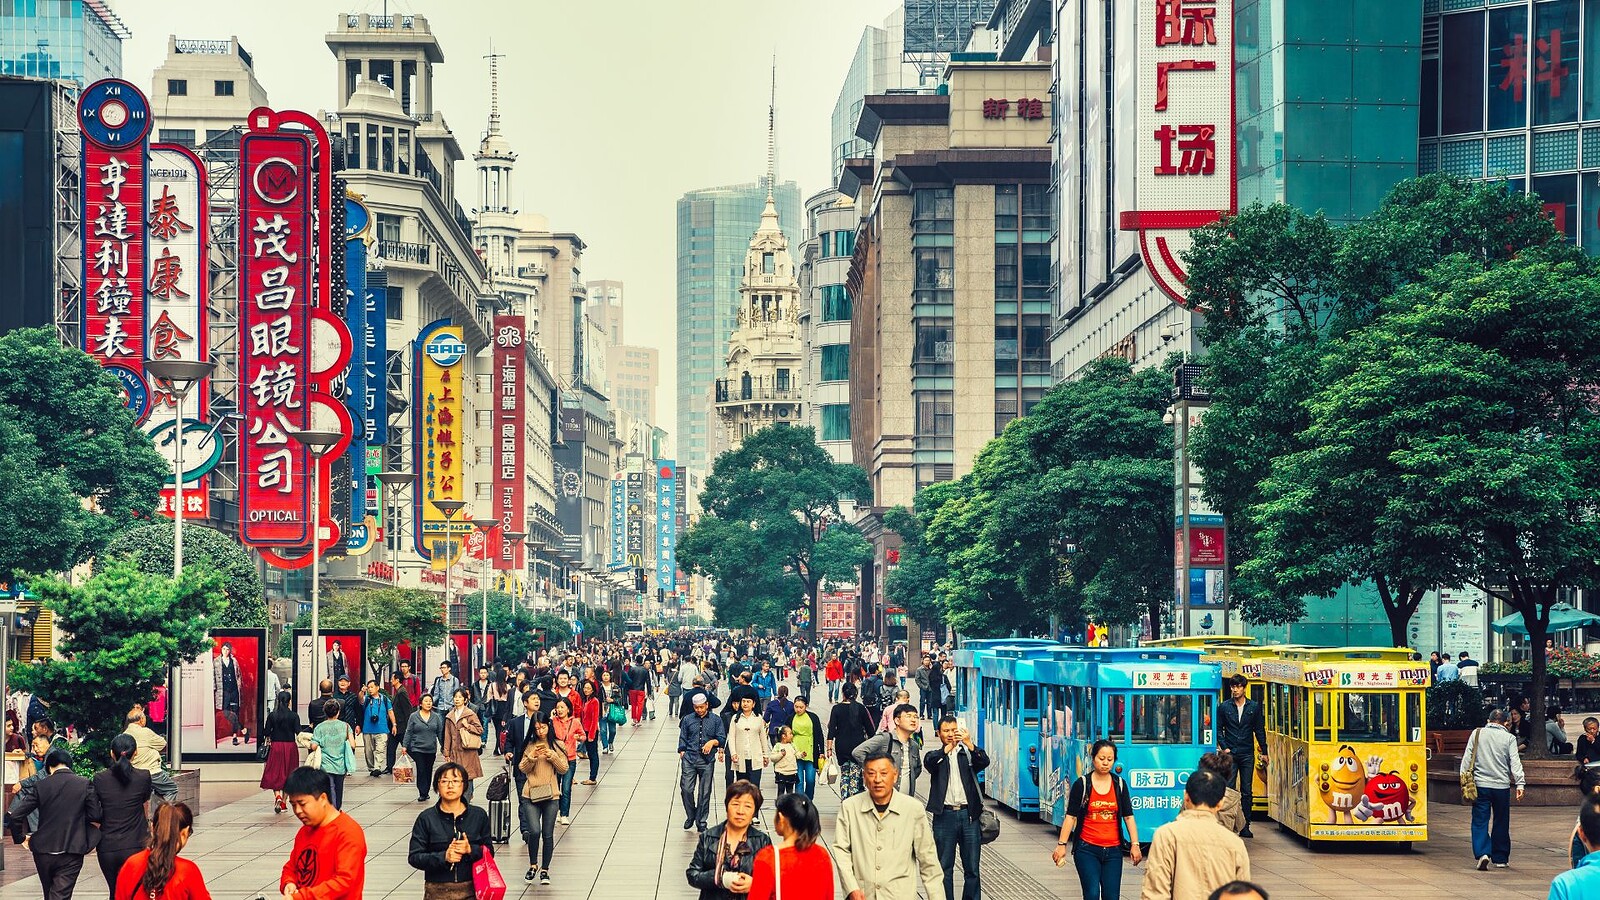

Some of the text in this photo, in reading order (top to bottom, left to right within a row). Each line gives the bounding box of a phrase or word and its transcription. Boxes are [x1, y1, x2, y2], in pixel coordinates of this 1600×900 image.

[1499, 29, 1569, 103] 料
[105, 86, 121, 95] XII
[1154, 0, 1217, 176] 际广场
[83, 109, 95, 117] IX
[132, 111, 144, 119] III
[983, 98, 1043, 121] 新雅
[107, 133, 120, 141] VI
[250, 213, 300, 494] 茂昌眼镜公司
[426, 344, 466, 354] BAC
[502, 354, 516, 479] 上海市第一食品商店
[250, 510, 300, 522] OPTICAL
[502, 487, 514, 560] First Foohall
[1153, 672, 1188, 681] 观光车
[1357, 672, 1394, 681] 观光车
[1205, 731, 1211, 743] 5
[1413, 729, 1419, 741] 7
[1136, 772, 1168, 787] 脉动
